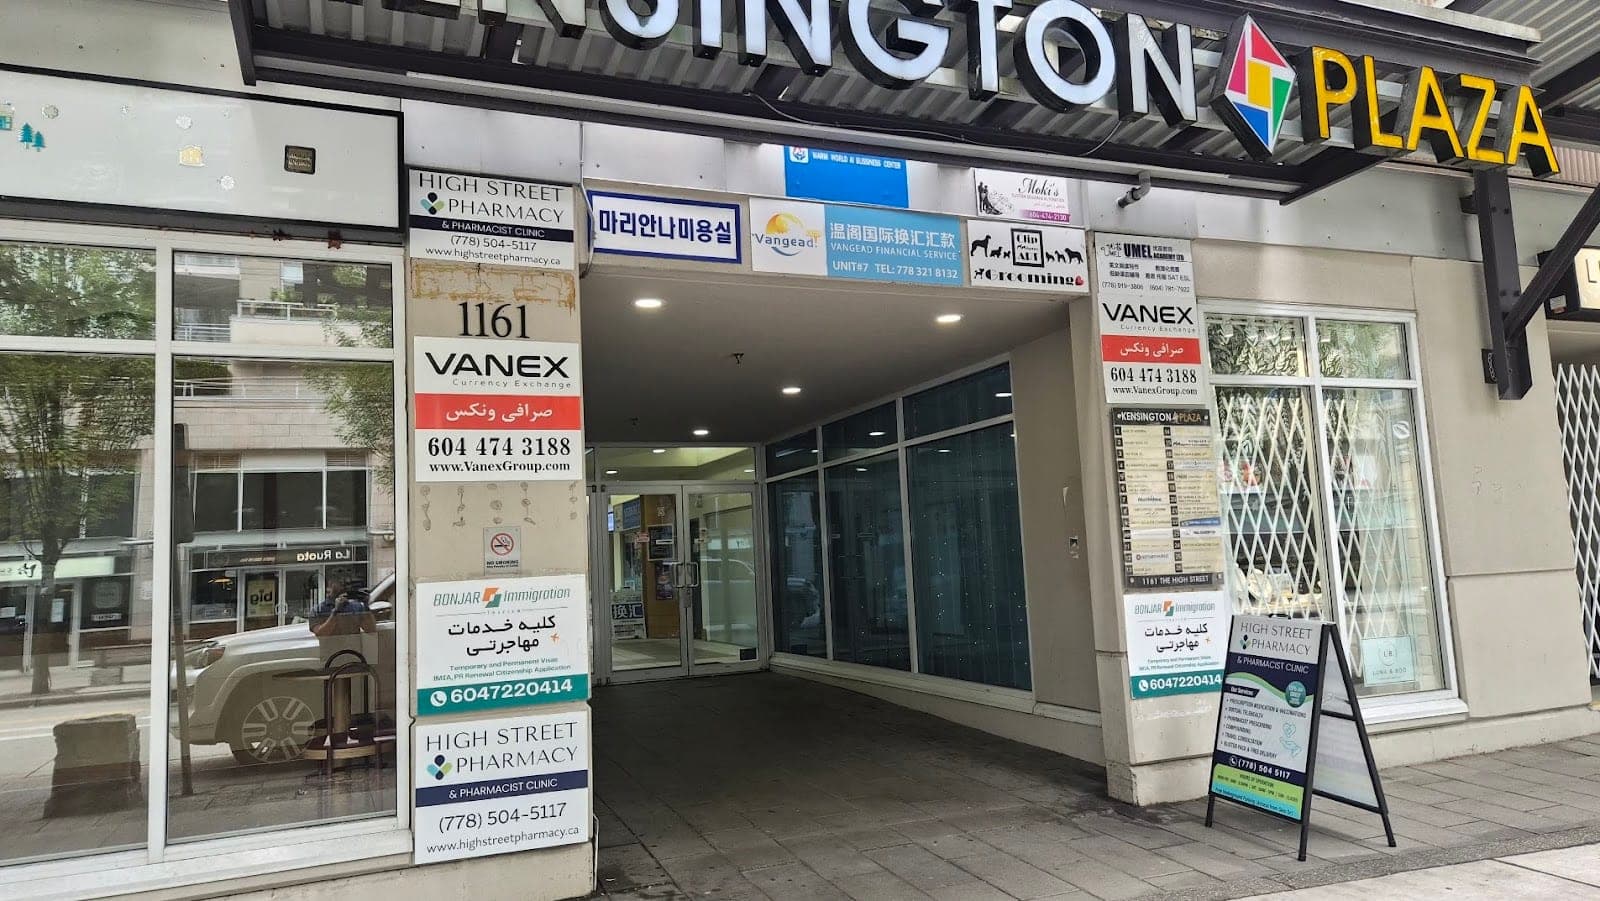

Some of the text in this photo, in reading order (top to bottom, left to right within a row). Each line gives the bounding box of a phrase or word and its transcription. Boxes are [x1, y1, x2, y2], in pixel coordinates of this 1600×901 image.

[1312, 46, 1560, 174] PLAZA
[419, 173, 565, 202] HIGH STREET
[449, 199, 564, 224] PHARMACY
[442, 221, 545, 238] & PHARMACIST CLINIC
[600, 210, 732, 245] 마리안나미용실
[830, 222, 955, 249] 温阁国际换汇汇款
[451, 235, 537, 251] (778) 504-5117
[831, 242, 958, 261] VANGEAD FINANCIAL SERVICE
[1124, 243, 1153, 259] UMEL
[426, 247, 561, 266] www.highstreetpharmacy.ca
[833, 261, 958, 279] UNIT#7 TEL: 778 321 8132
[986, 269, 1074, 286] Grooming
[459, 302, 530, 339] 1161
[1103, 303, 1194, 325] VANEX
[1121, 324, 1156, 332] Currency
[1120, 342, 1184, 358] صرافی ونکس
[425, 352, 570, 379] VANEX
[453, 378, 572, 390] Currency Exchange
[1111, 367, 1197, 384] 604 474 3188
[1113, 386, 1198, 397] www.VanexGroup.com
[446, 403, 553, 423] صرافی ونکس
[1121, 411, 1201, 422] KENSINGTON PLAZA
[428, 437, 571, 457] 604 474 3188
[430, 461, 570, 473] www.VanexGroup.com
[1160, 577, 1171, 585] THE
[433, 592, 481, 607] BONJAR
[614, 604, 643, 619] 换汇
[1135, 604, 1162, 615] BONJAR
[448, 615, 556, 636] کلیه خدمات
[1145, 623, 1208, 637] کلیه خدمات
[1241, 622, 1312, 640] HIGH STREET
[466, 636, 540, 656] مهاجرتی
[1156, 639, 1200, 653] مهاجرتی
[1252, 639, 1312, 656] PHARMACY
[450, 662, 488, 671] Temporary
[503, 658, 540, 667] Permanent
[465, 671, 495, 680] Renewal
[496, 667, 533, 676] Citizenship
[535, 665, 571, 673] Application
[1237, 656, 1310, 674] & PHARMACIST CLINIC
[1150, 674, 1222, 690] 6047220414
[451, 679, 573, 704] 6047220414
[427, 722, 578, 752] HIGH STREET
[457, 746, 578, 773] PHARMACY
[1238, 759, 1291, 780] (778) 504 5117
[449, 779, 558, 800] & PHARMACIST CLINIC
[439, 802, 567, 834] (778) 504-5117
[427, 825, 579, 854] www.highstreetpharmacy.ca
